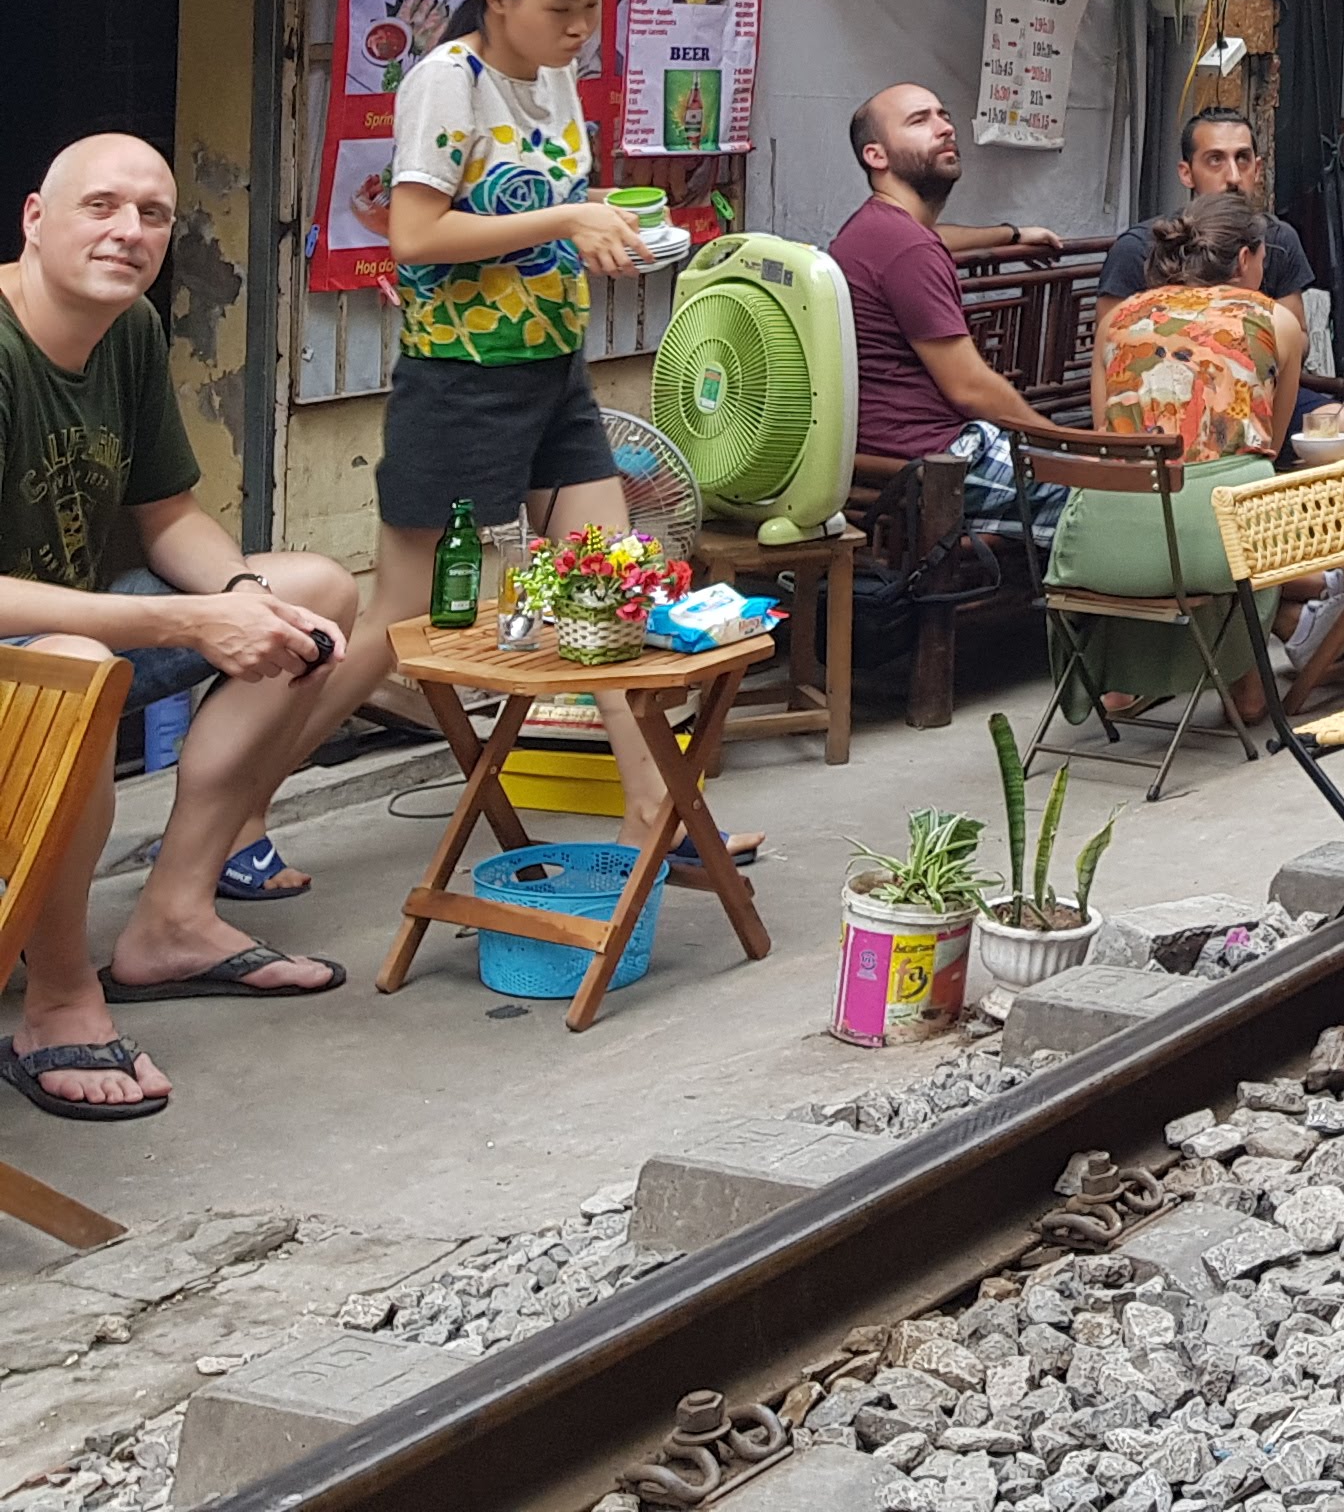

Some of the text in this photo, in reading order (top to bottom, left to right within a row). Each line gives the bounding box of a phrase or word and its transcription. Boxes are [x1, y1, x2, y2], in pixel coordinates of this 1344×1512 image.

[669, 46, 711, 61] BEER
[355, 260, 377, 277] Hog
[226, 867, 253, 885] NIKE
